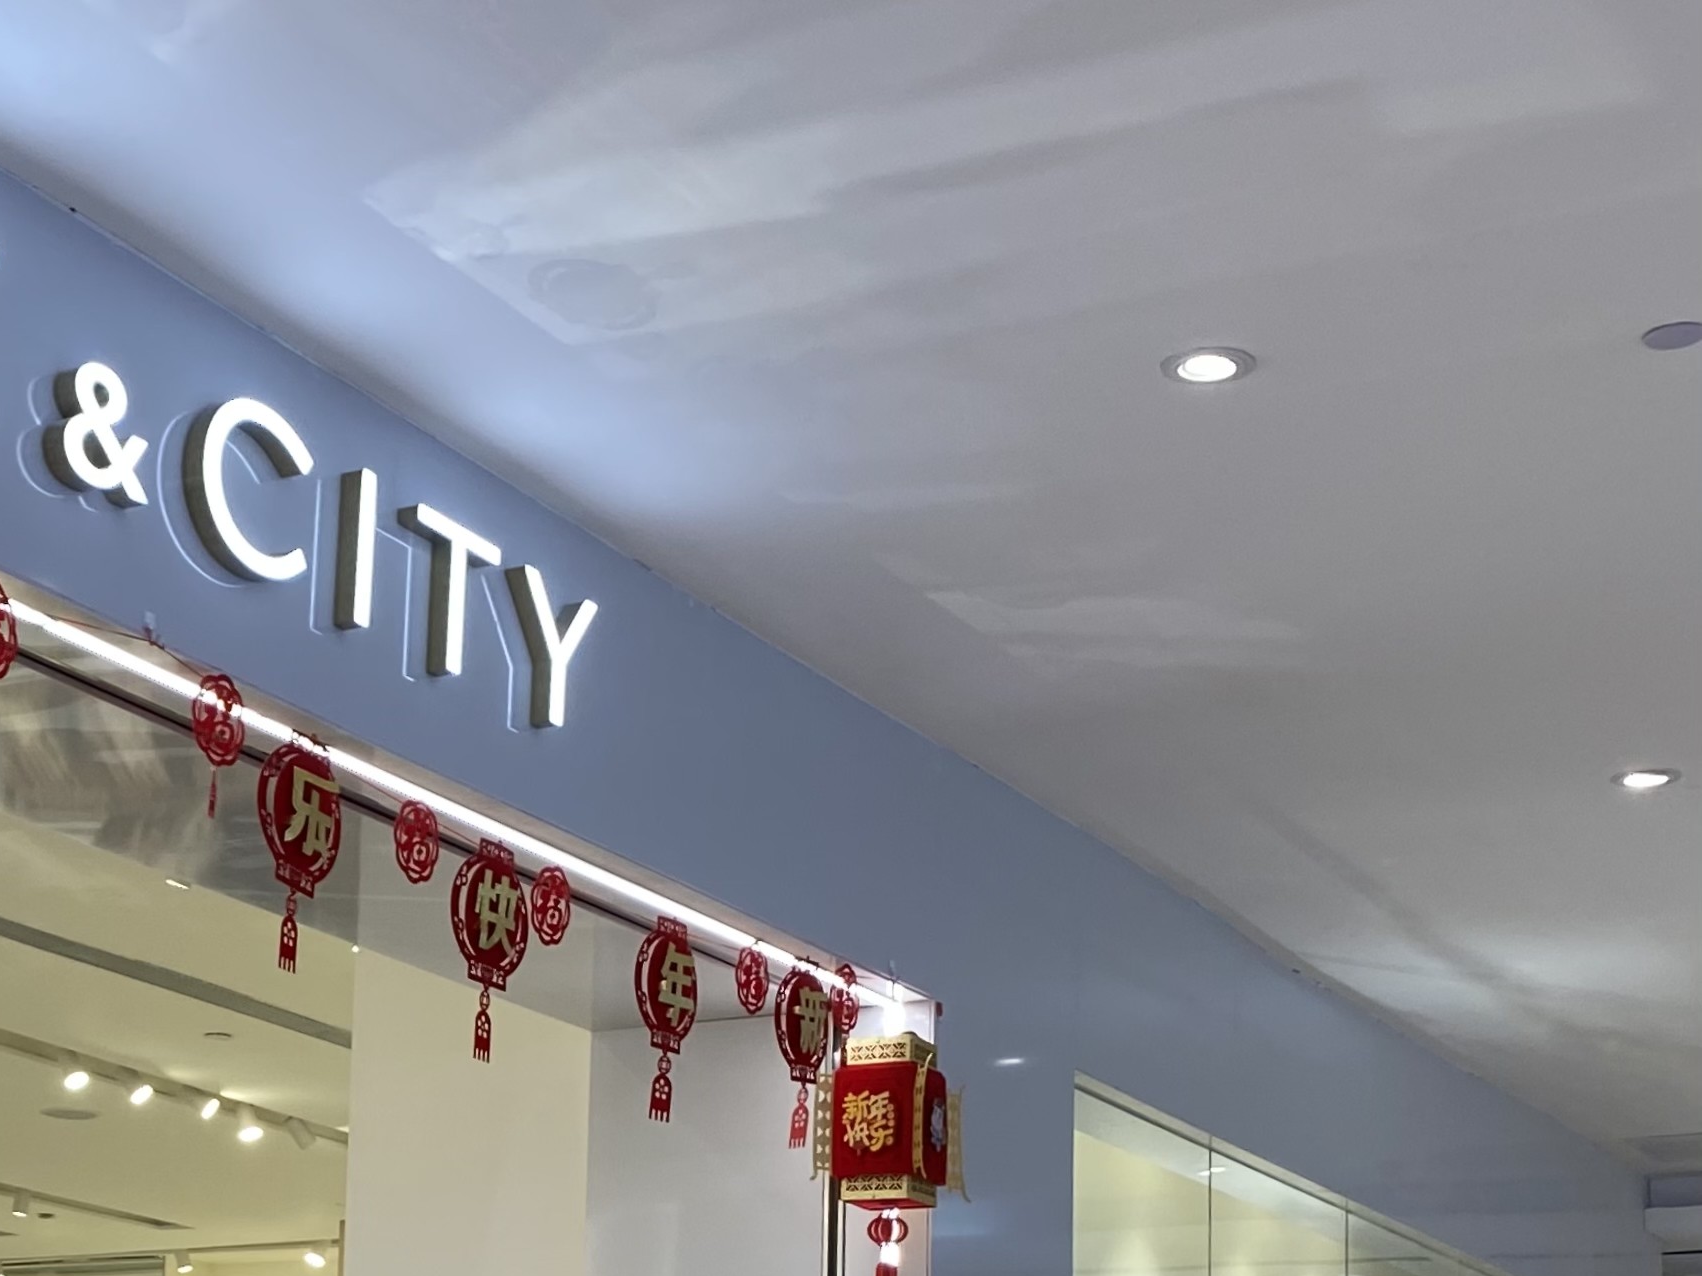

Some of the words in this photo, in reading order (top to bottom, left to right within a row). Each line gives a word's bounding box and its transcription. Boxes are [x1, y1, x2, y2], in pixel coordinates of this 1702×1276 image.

[42, 361, 149, 507] &
[184, 397, 598, 727] CITY
[475, 869, 519, 954] 快
[659, 941, 696, 1026] 年
[842, 1090, 889, 1121] 新年
